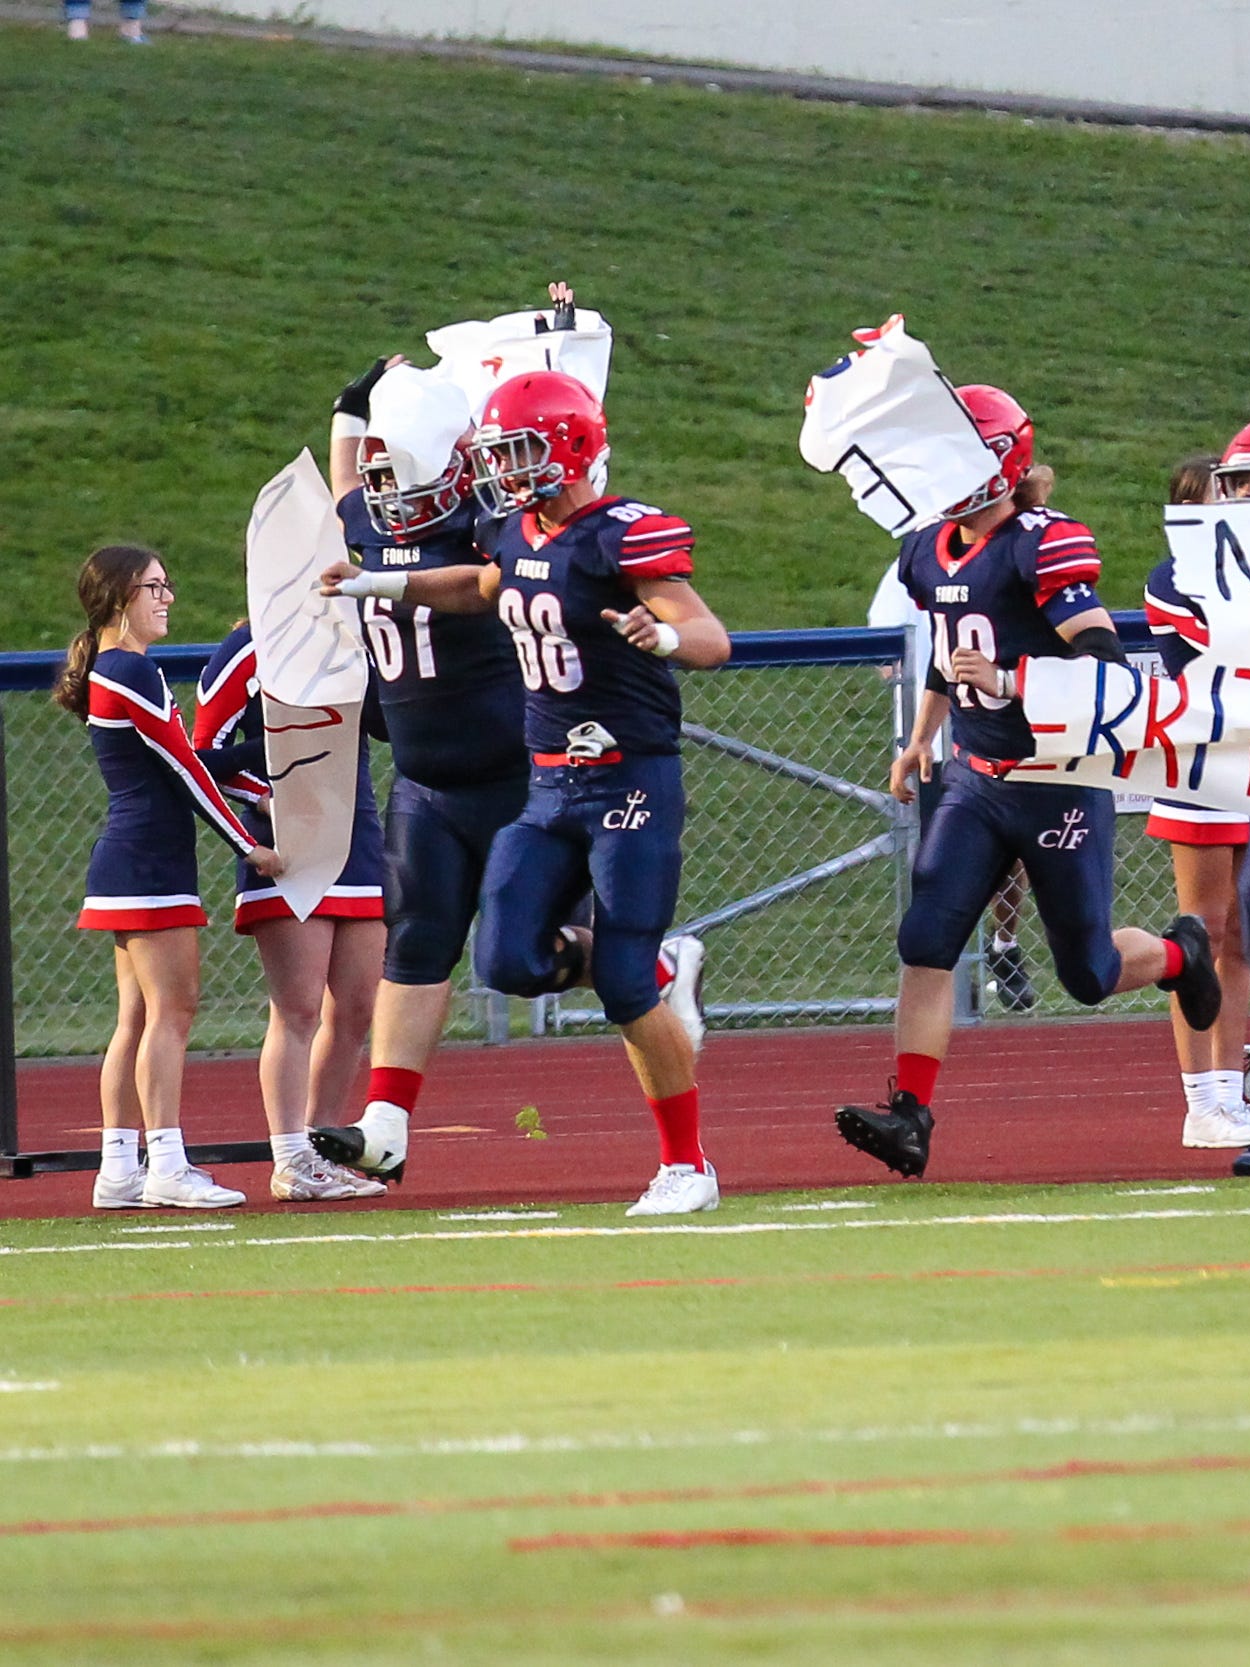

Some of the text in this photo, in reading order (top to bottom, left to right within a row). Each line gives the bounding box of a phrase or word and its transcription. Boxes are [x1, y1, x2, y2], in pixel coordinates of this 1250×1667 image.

[383, 546, 421, 566] FORKS
[515, 558, 551, 580] FORKS
[935, 585, 969, 604] FORKS
[499, 588, 584, 693] 88
